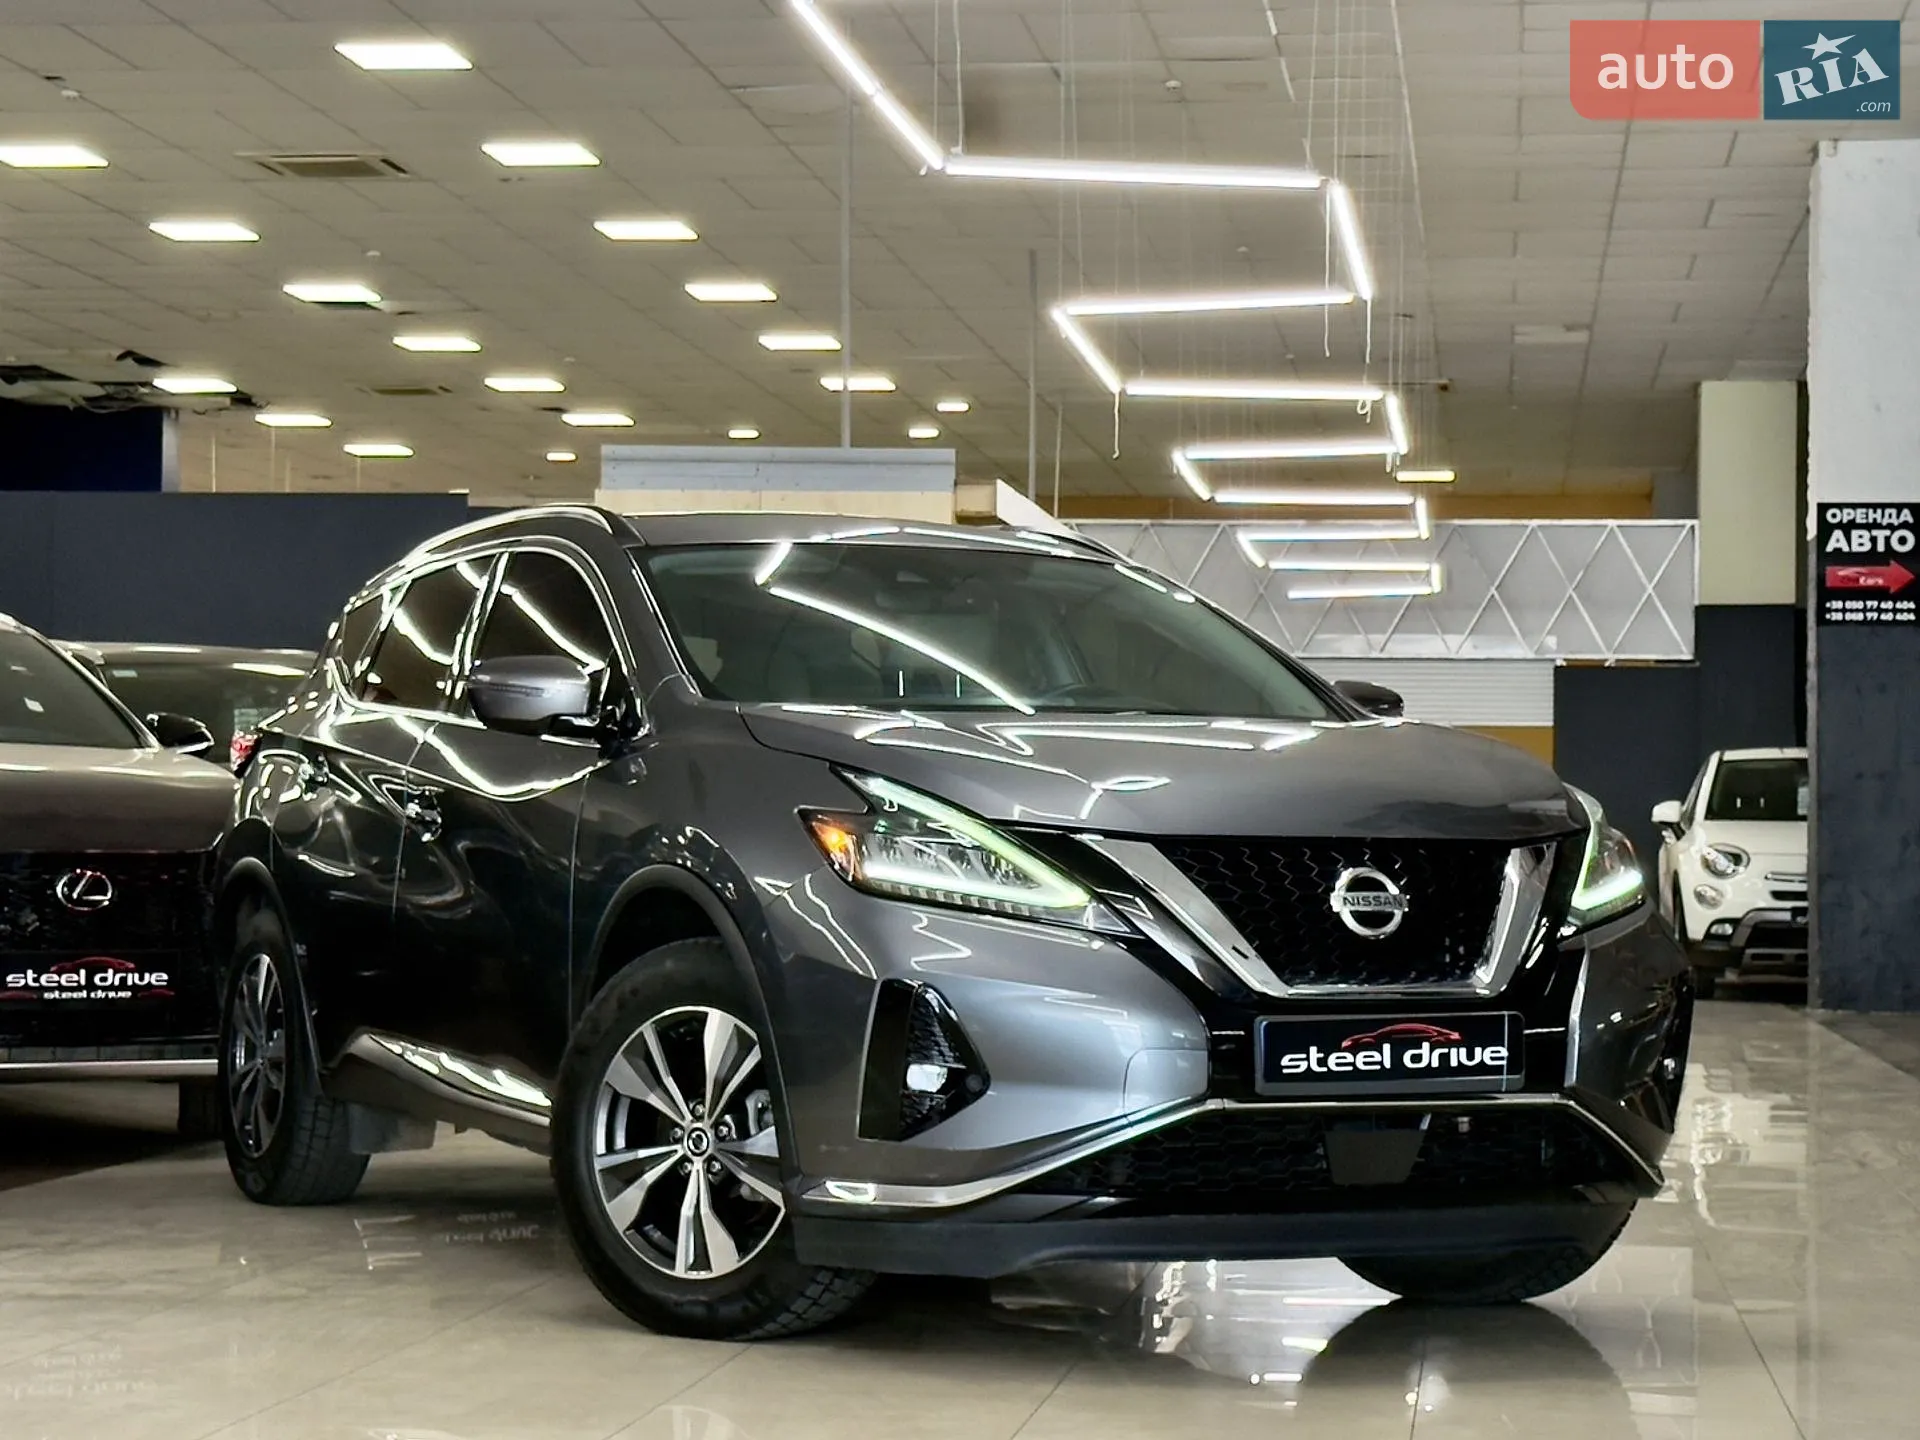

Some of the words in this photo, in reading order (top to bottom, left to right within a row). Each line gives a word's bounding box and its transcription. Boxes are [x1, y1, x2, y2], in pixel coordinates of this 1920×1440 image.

[1825, 508, 1914, 526] ОРЕНДА
[1825, 529, 1916, 553] АВТО
[1342, 894, 1404, 908] NISSAN
[6, 968, 86, 987] steel
[93, 968, 169, 986] drive
[43, 990, 87, 999] steel
[90, 990, 132, 999] drive
[1280, 1043, 1390, 1074] steel
[1402, 1041, 1509, 1069] drive
